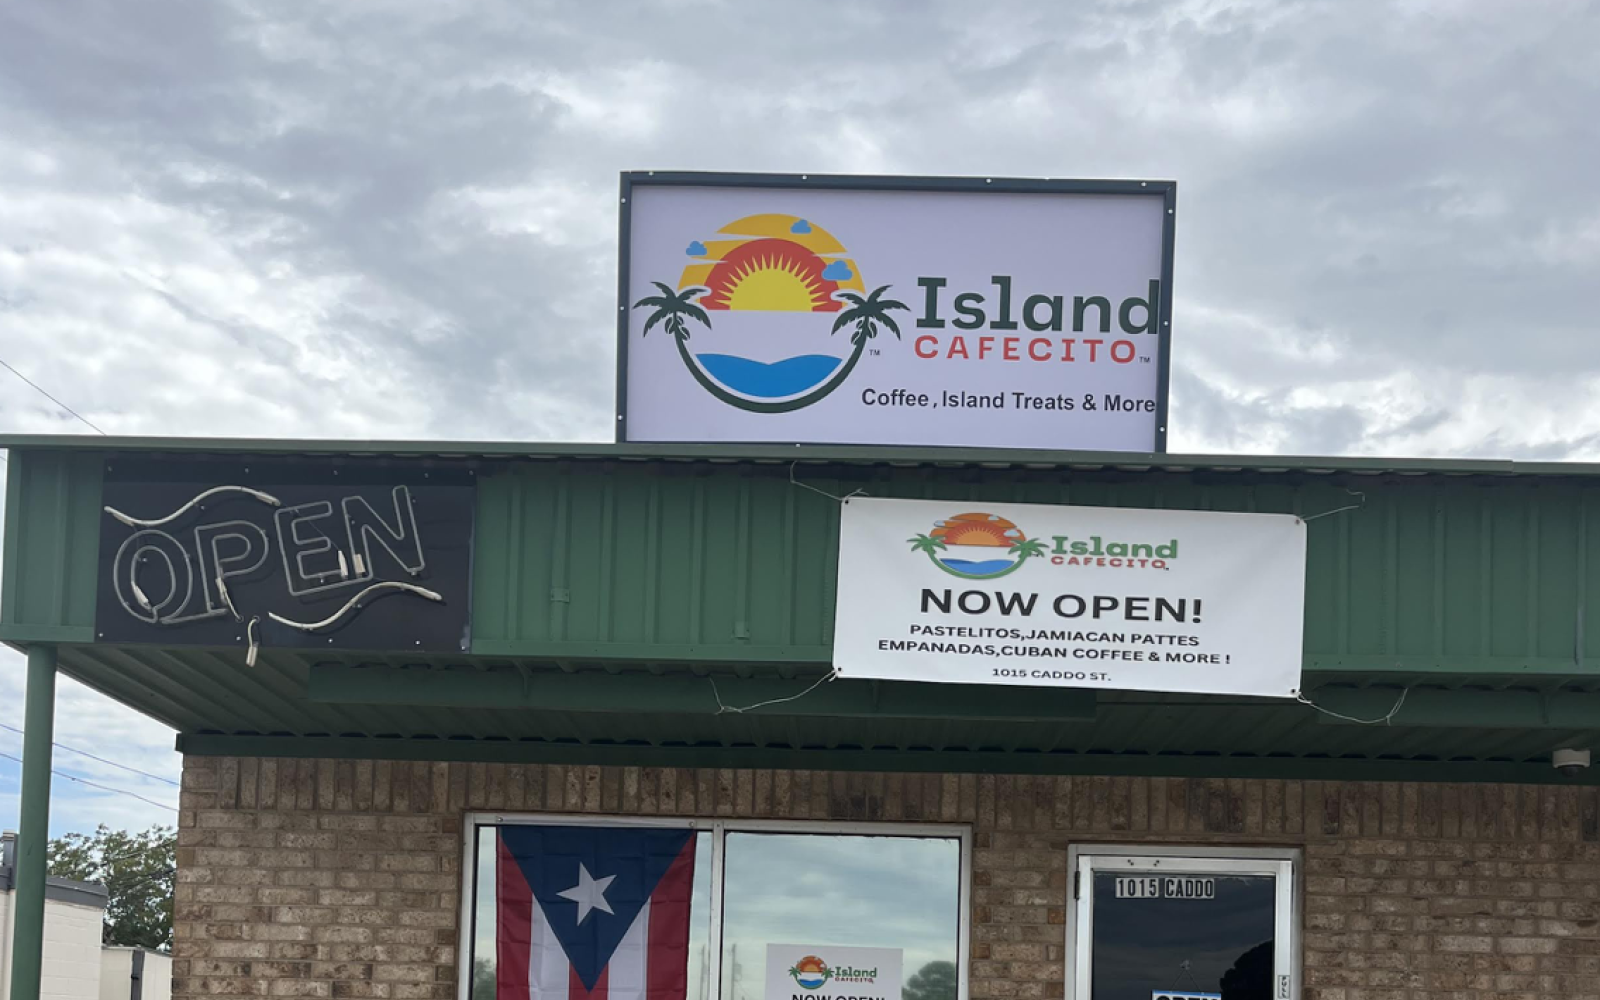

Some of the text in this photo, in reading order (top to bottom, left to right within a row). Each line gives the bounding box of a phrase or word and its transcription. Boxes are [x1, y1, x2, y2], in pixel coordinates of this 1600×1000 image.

[917, 275, 1159, 335] Island
[914, 335, 1136, 364] CAFECITO
[942, 390, 1005, 408] Island
[1012, 392, 1075, 410] Treats
[1082, 393, 1097, 411] &
[1103, 394, 1156, 412] More
[113, 484, 426, 625] OPEN
[1050, 535, 1179, 559] Island
[1050, 555, 1167, 569] CAFECITO
[920, 588, 1203, 624] NOW OPEN!
[1130, 633, 1200, 647] PATTES
[1072, 648, 1144, 662] COFFEE
[1148, 651, 1161, 662] &
[993, 668, 1112, 682] 1015 CADDO ST.
[1117, 878, 1214, 898] 1015 CADDO
[834, 966, 878, 978] Island
